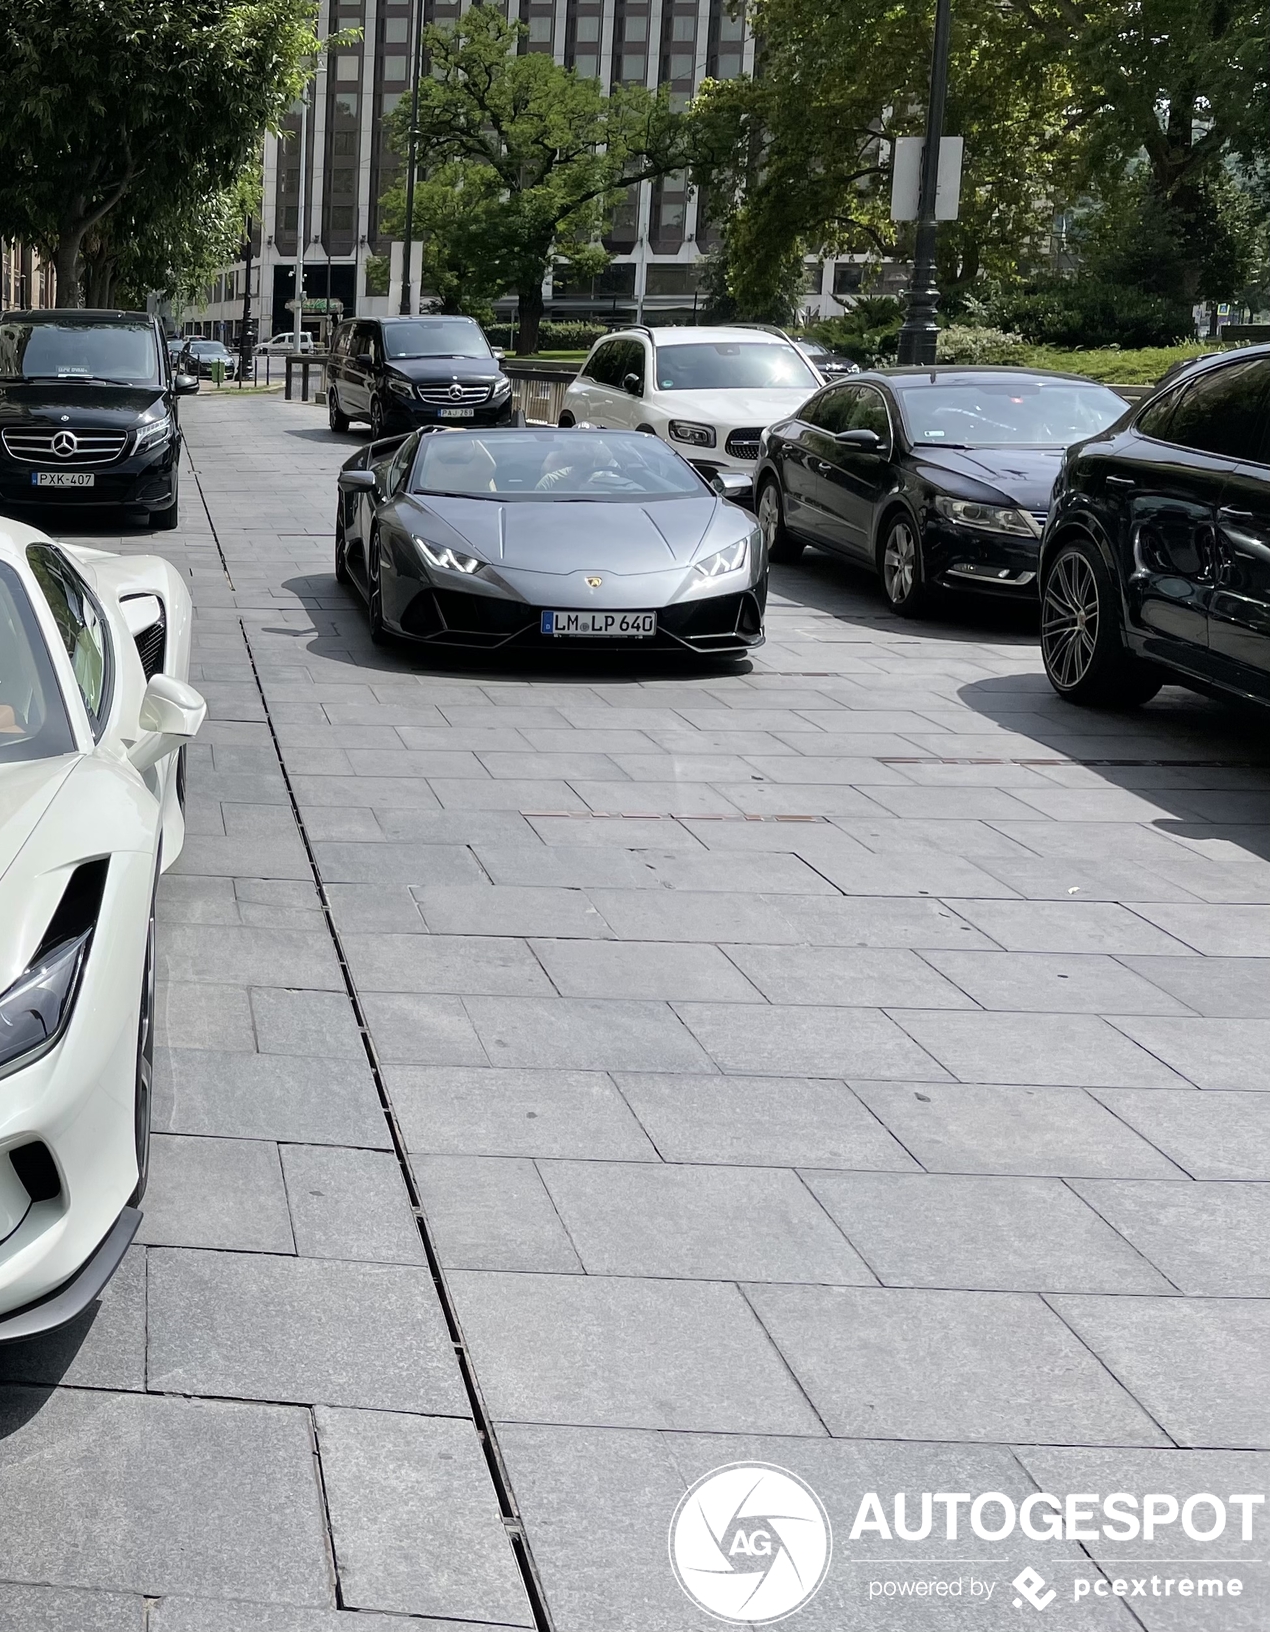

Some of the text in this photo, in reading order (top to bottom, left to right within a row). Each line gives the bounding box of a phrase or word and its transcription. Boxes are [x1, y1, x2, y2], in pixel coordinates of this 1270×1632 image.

[40, 474, 91, 485] PXK-407
[555, 614, 579, 631] LM
[591, 615, 615, 632] LP
[619, 615, 653, 632] 640
